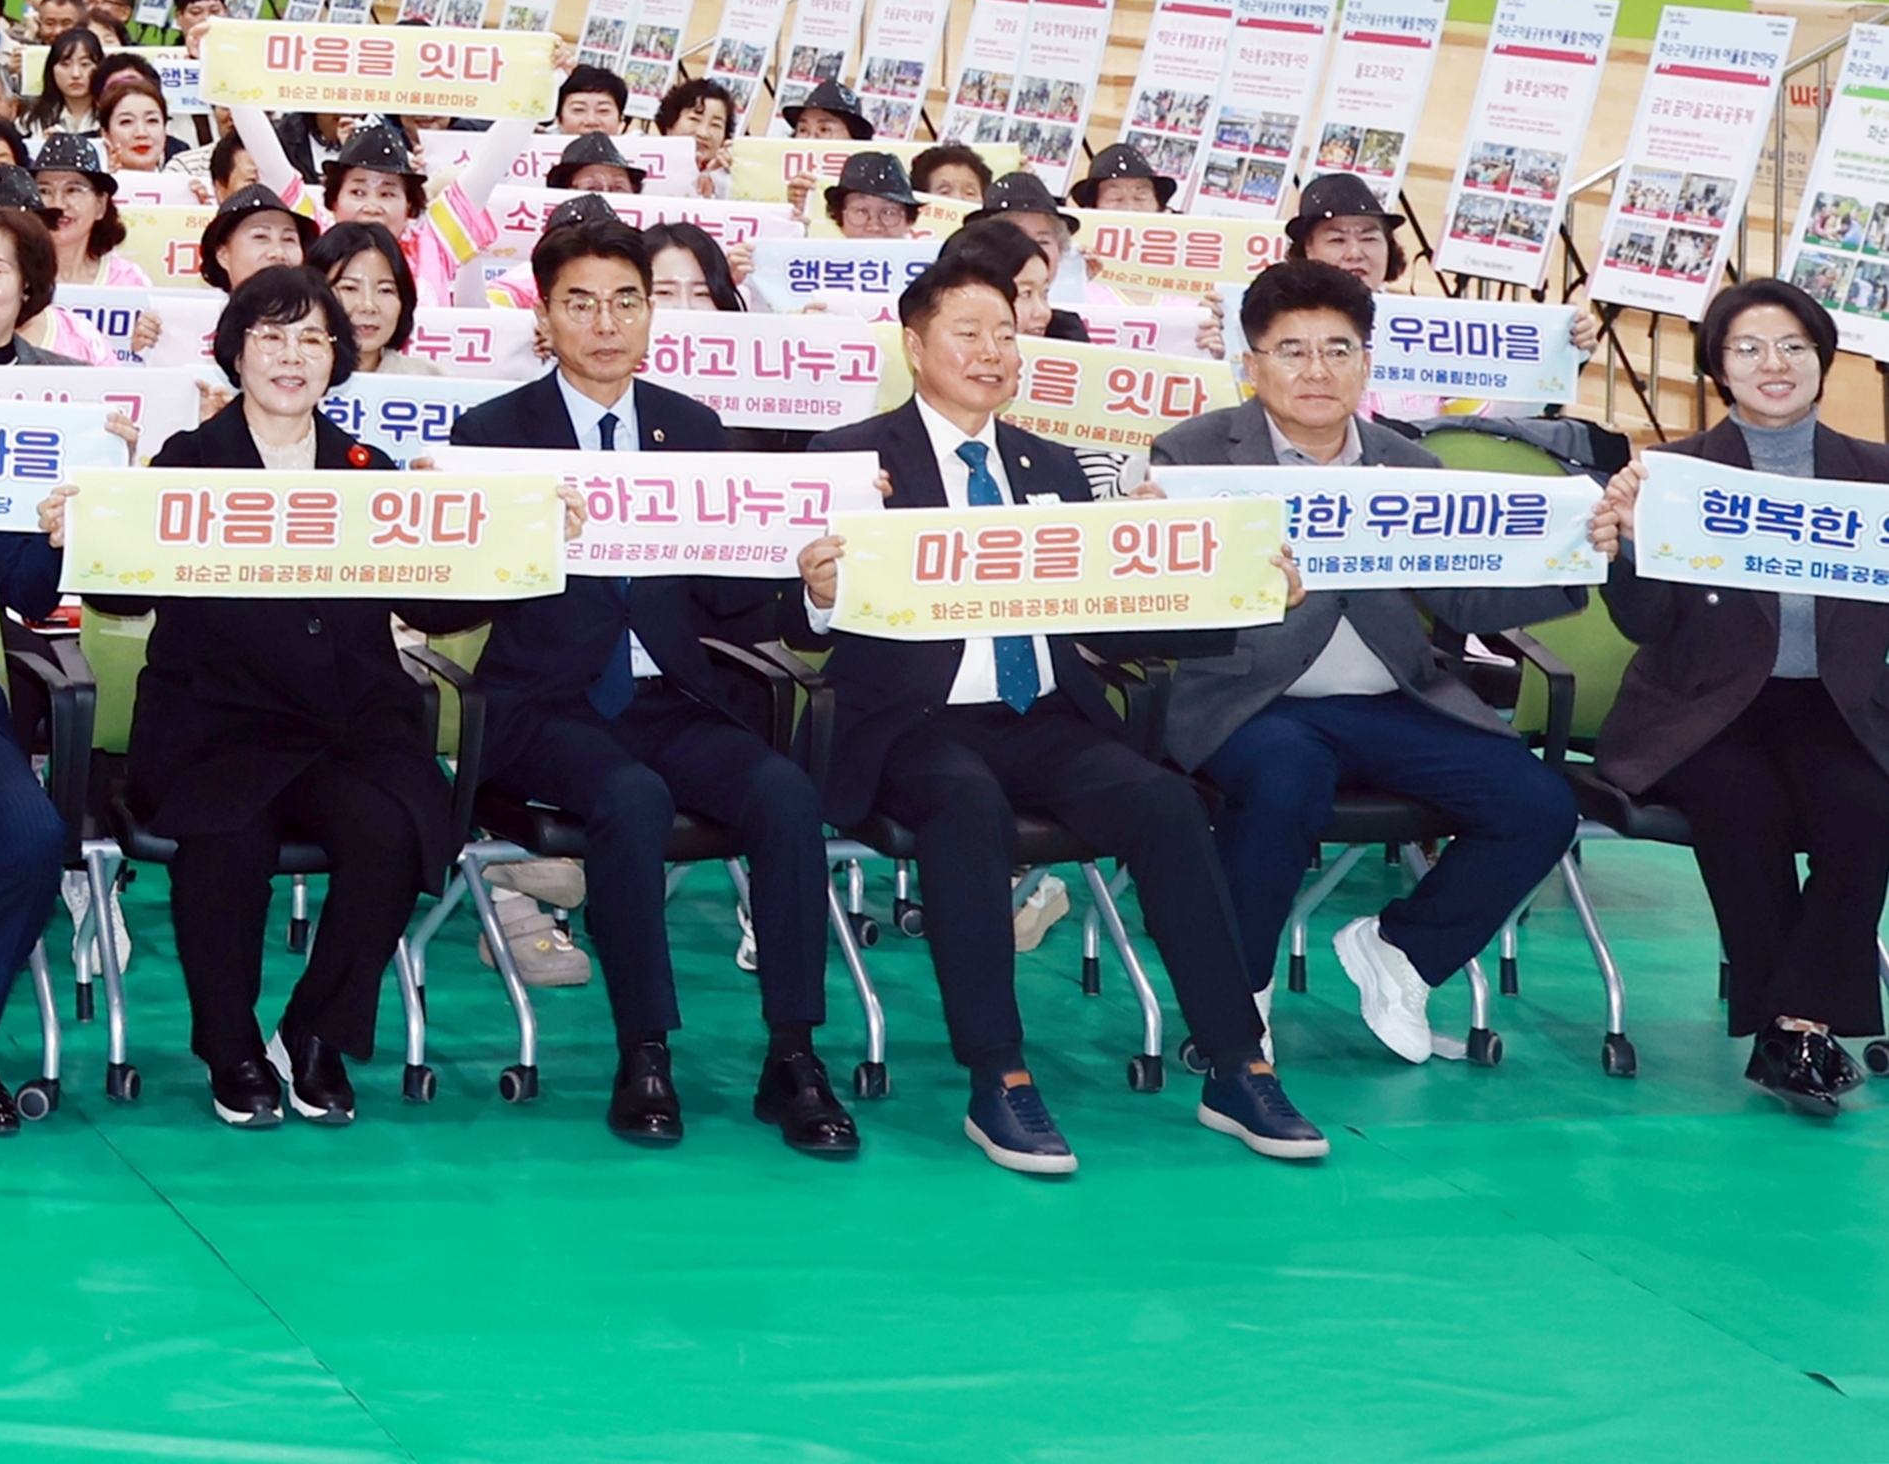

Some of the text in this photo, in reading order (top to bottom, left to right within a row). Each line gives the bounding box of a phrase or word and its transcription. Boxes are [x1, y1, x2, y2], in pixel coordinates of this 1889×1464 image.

[267, 32, 507, 84] 마음을 잇다
[277, 84, 478, 108] 화순군 마을공동체 어울림한마당
[1504, 79, 1569, 101] 늘푸른실버대학
[1095, 226, 1223, 262] 마음을
[787, 258, 891, 293] 행복한
[1100, 271, 1142, 285] 화순군
[399, 325, 492, 365] 누고
[1390, 318, 1541, 363] 우리마을
[753, 336, 880, 384] 나누고
[1370, 363, 1508, 390] 공동체 어울림한마당
[745, 394, 842, 416] 어울림한마당
[1106, 367, 1208, 418] 잇다
[159, 491, 487, 547] 마음을 잇다
[696, 476, 831, 528] 나누고
[1365, 492, 1549, 540] 우리마을
[1700, 488, 1863, 546] 행복한
[589, 541, 788, 563] 마을공동체 어울림한마당
[913, 521, 1218, 583] 마음을 잇다
[1307, 552, 1503, 574] 마을공동체 어울림한마당
[1744, 553, 1804, 578] 화순군
[174, 562, 452, 585] 화순군 마을공동체 어울림한마당
[931, 593, 1190, 621] 화순군 마을공동체 어울림한마당
